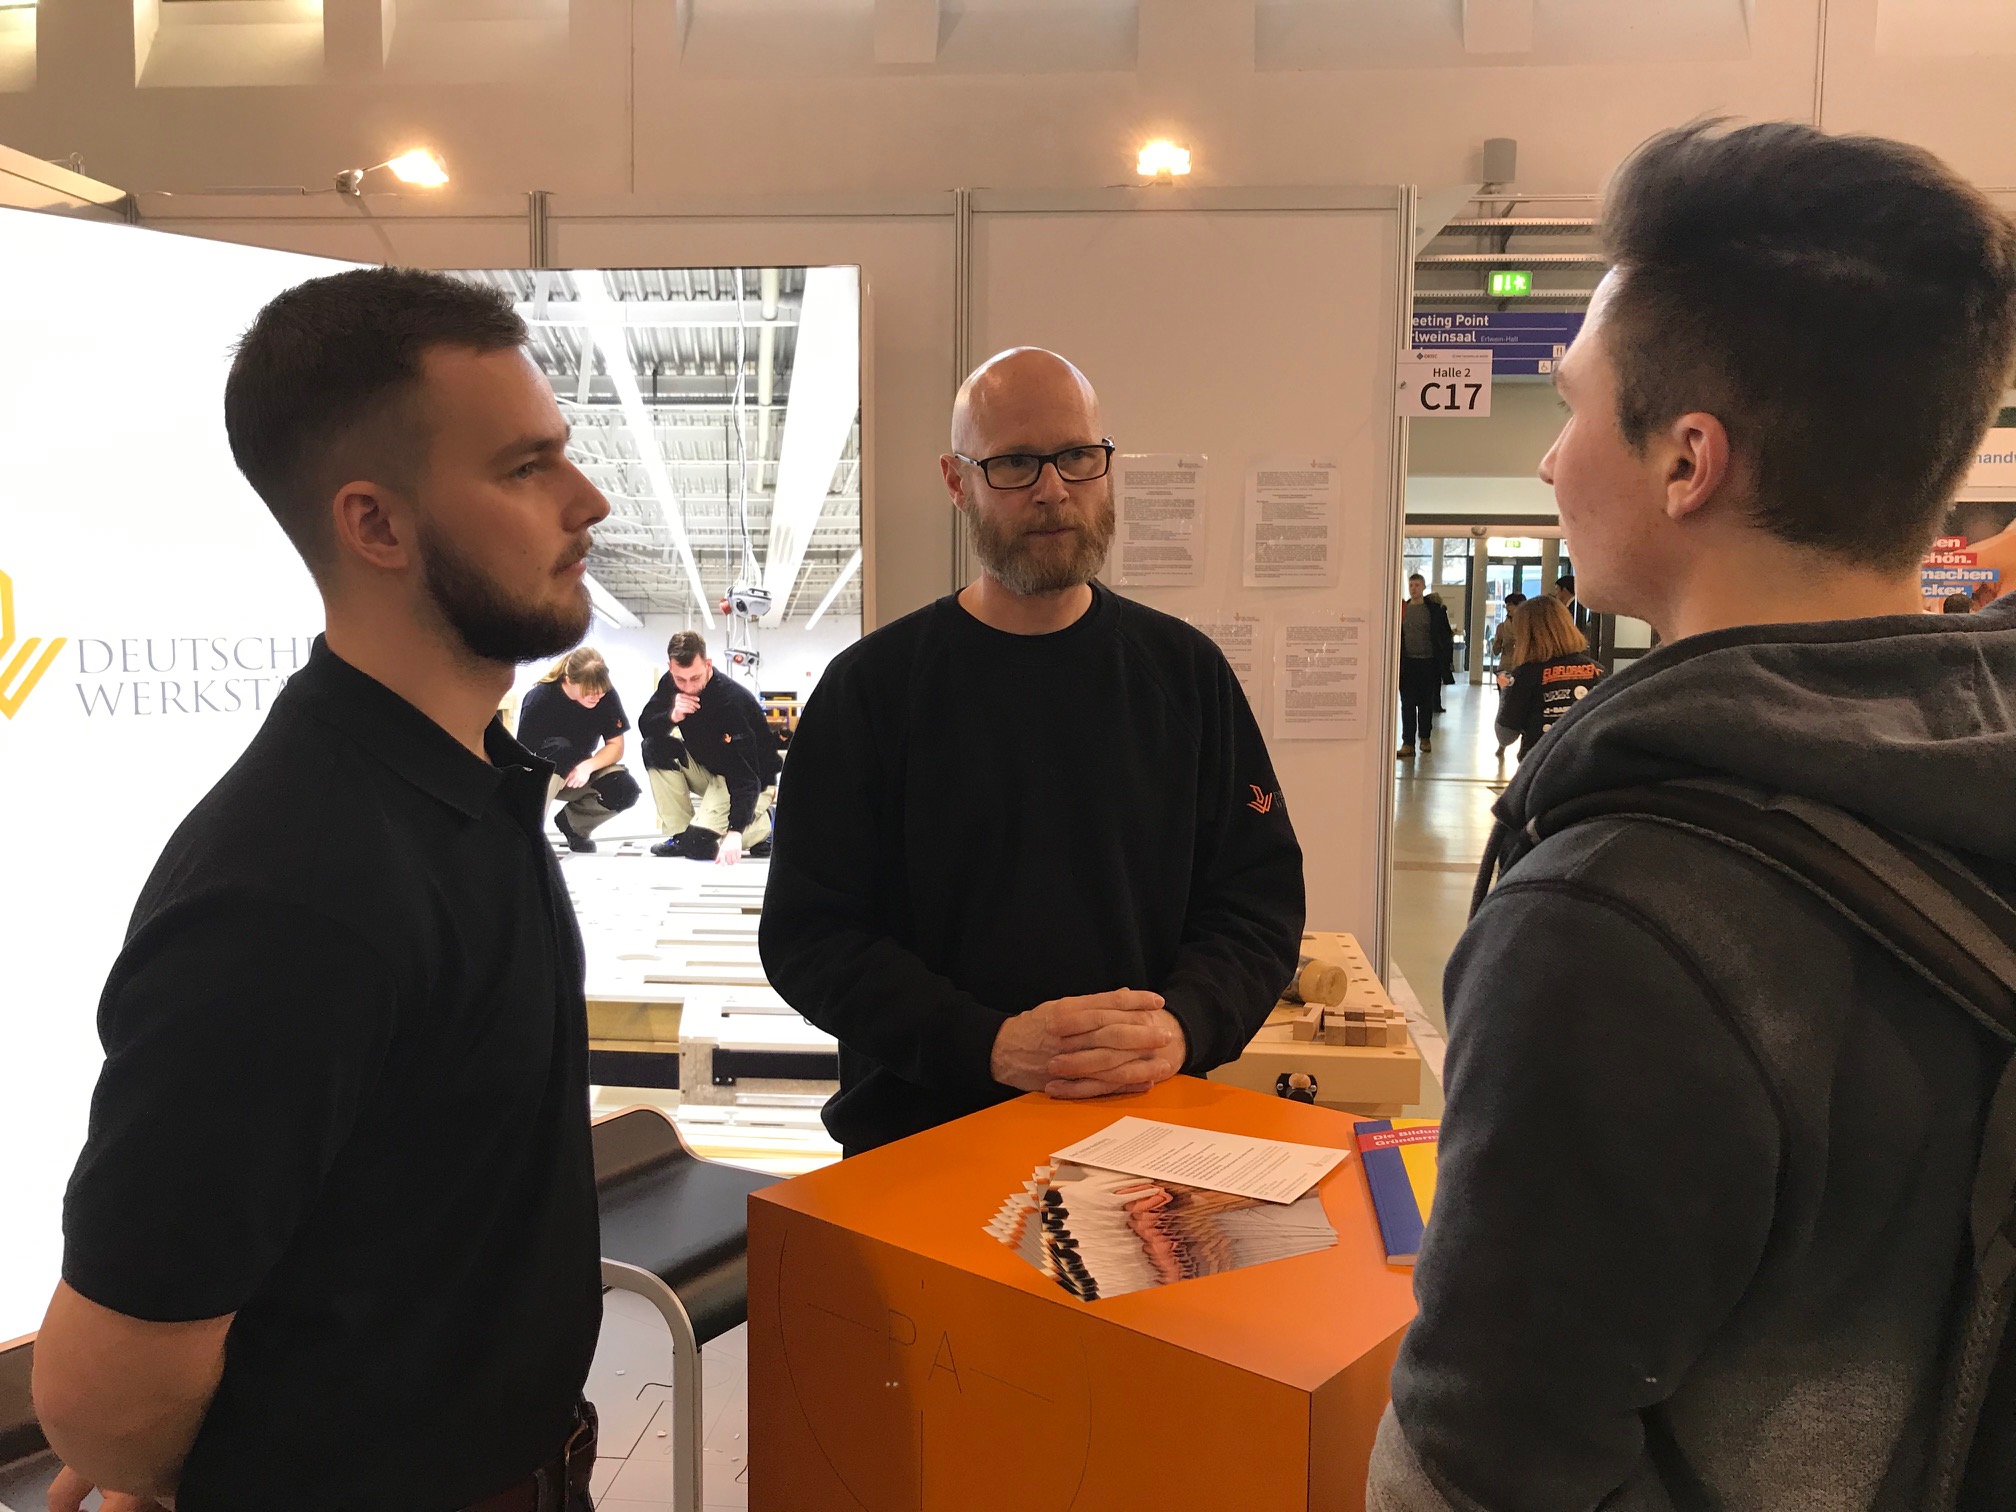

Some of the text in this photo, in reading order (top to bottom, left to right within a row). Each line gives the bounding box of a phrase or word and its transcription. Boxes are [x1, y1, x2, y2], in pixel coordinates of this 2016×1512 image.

[1456, 314, 1489, 326] Point
[1433, 367, 1471, 378] Halle 2
[1420, 382, 1483, 411] C17
[1976, 451, 2016, 464] and
